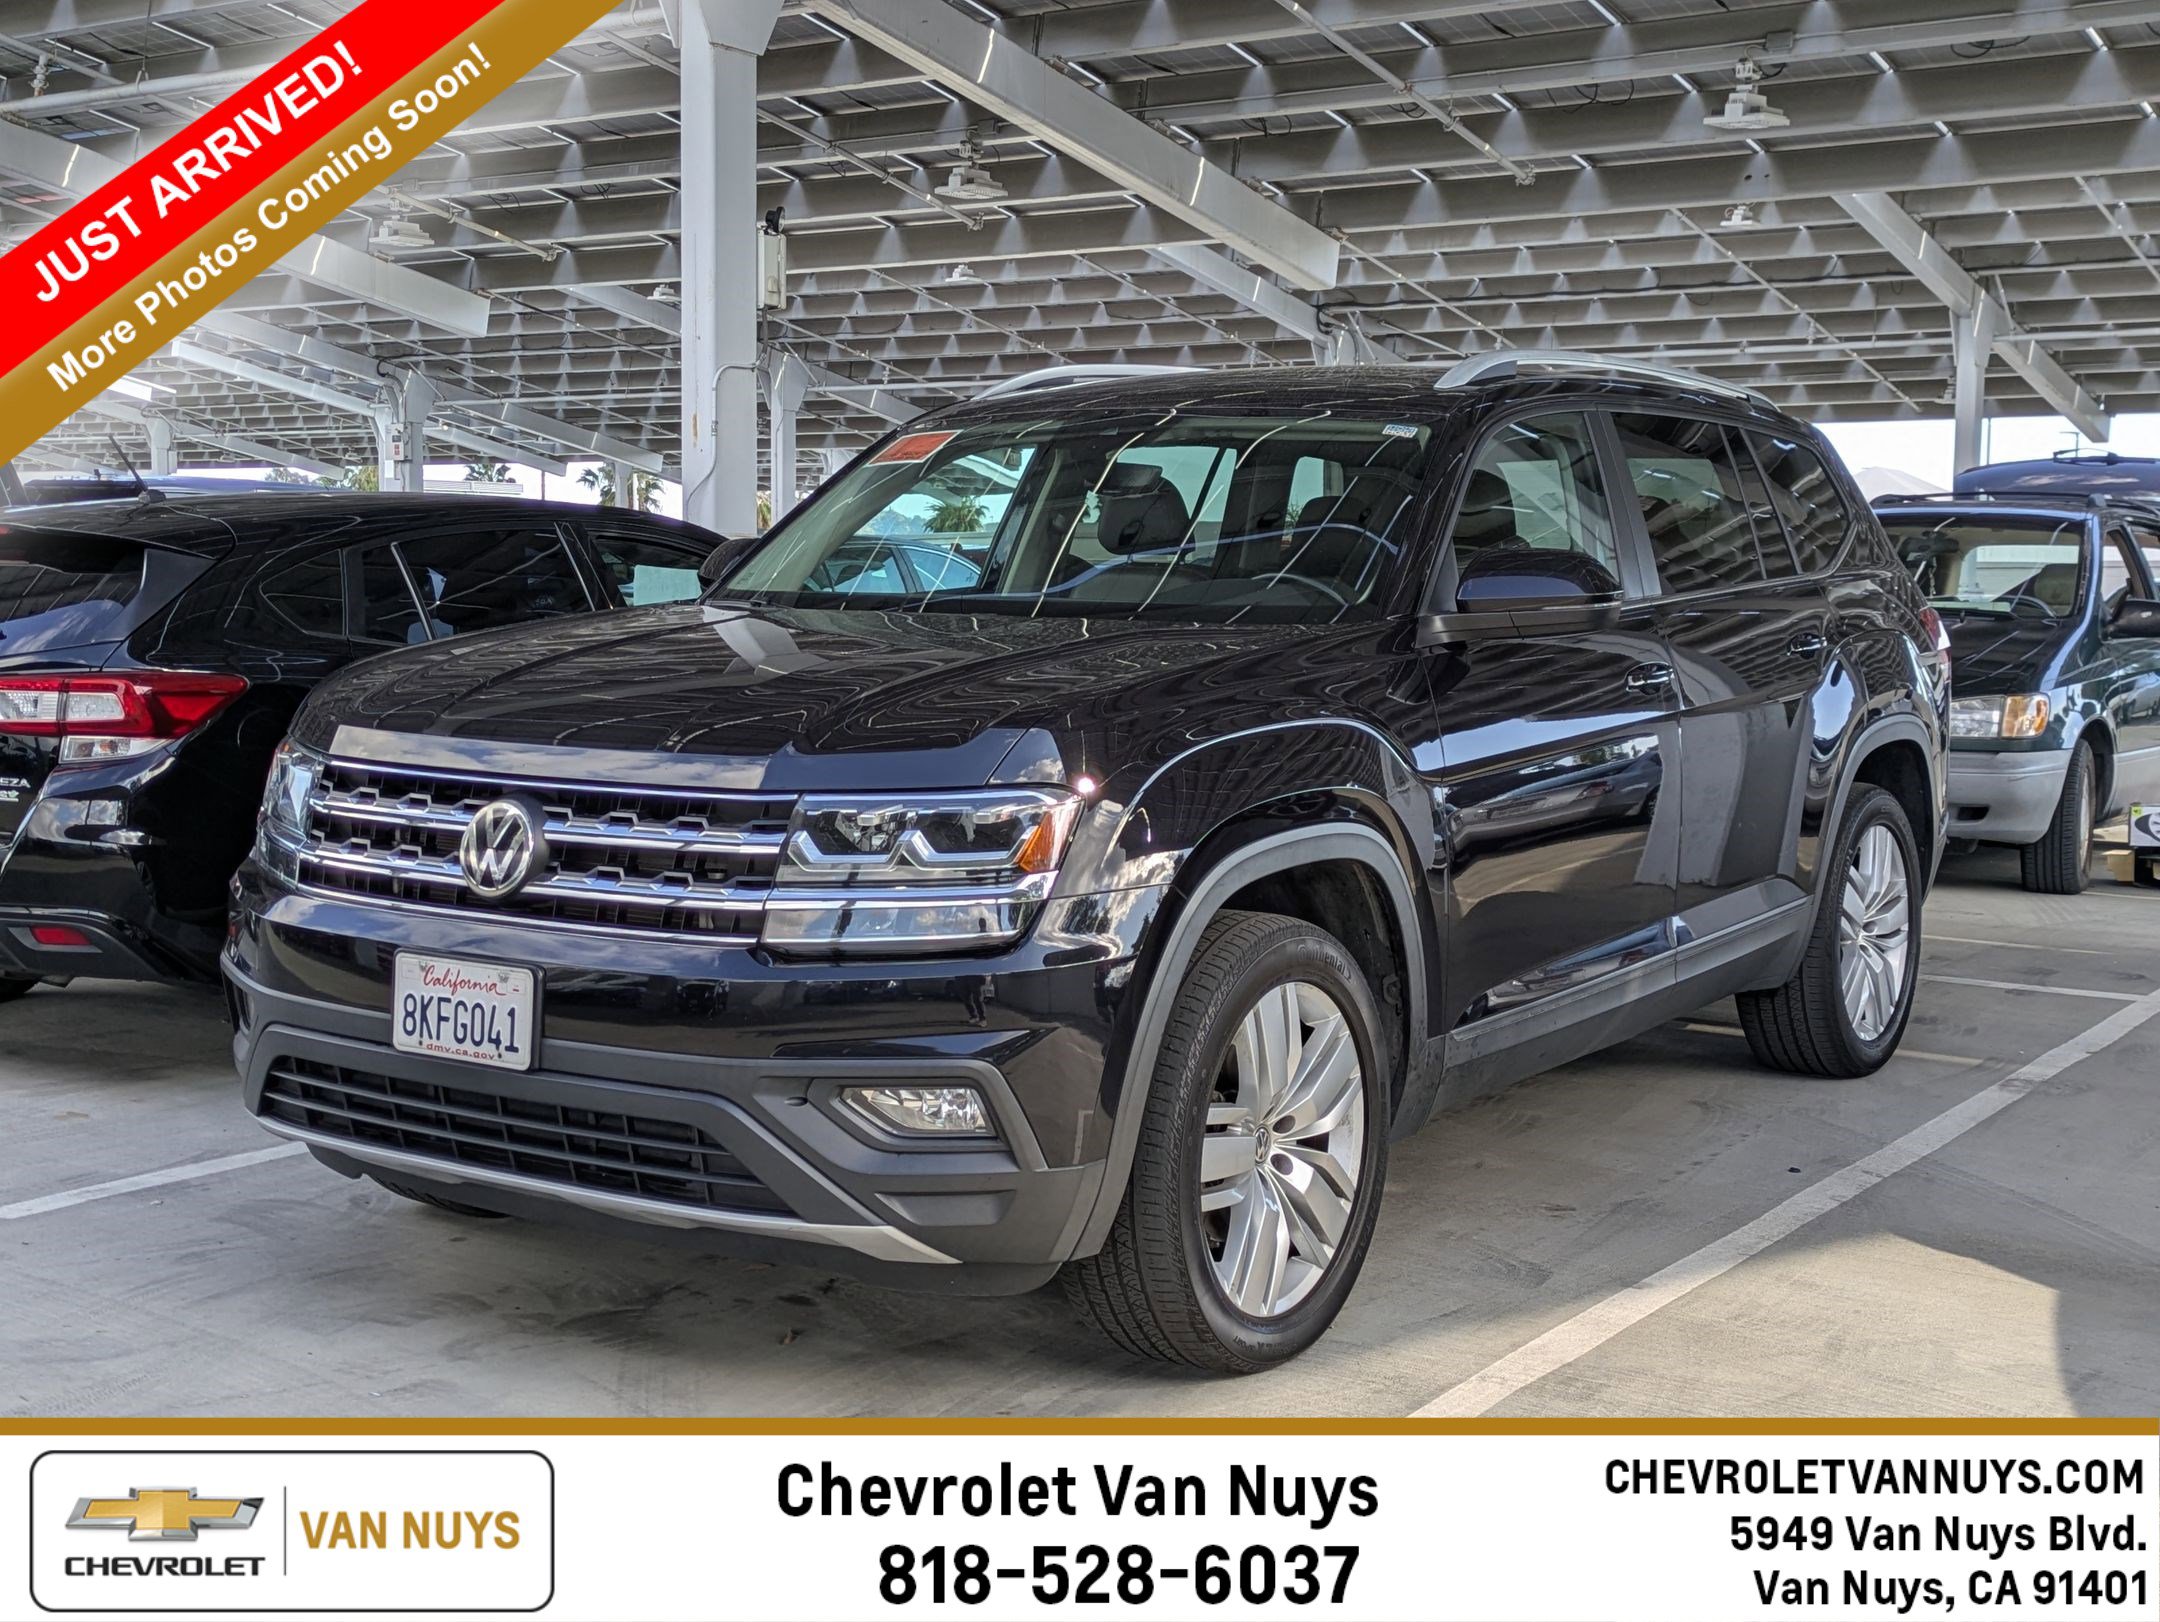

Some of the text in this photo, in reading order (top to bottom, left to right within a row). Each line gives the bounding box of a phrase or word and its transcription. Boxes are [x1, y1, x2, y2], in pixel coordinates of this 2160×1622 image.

[423, 965, 507, 996] California
[402, 992, 520, 1053] 8KFG041
[426, 1042, 495, 1060] dmv.ca.gov
